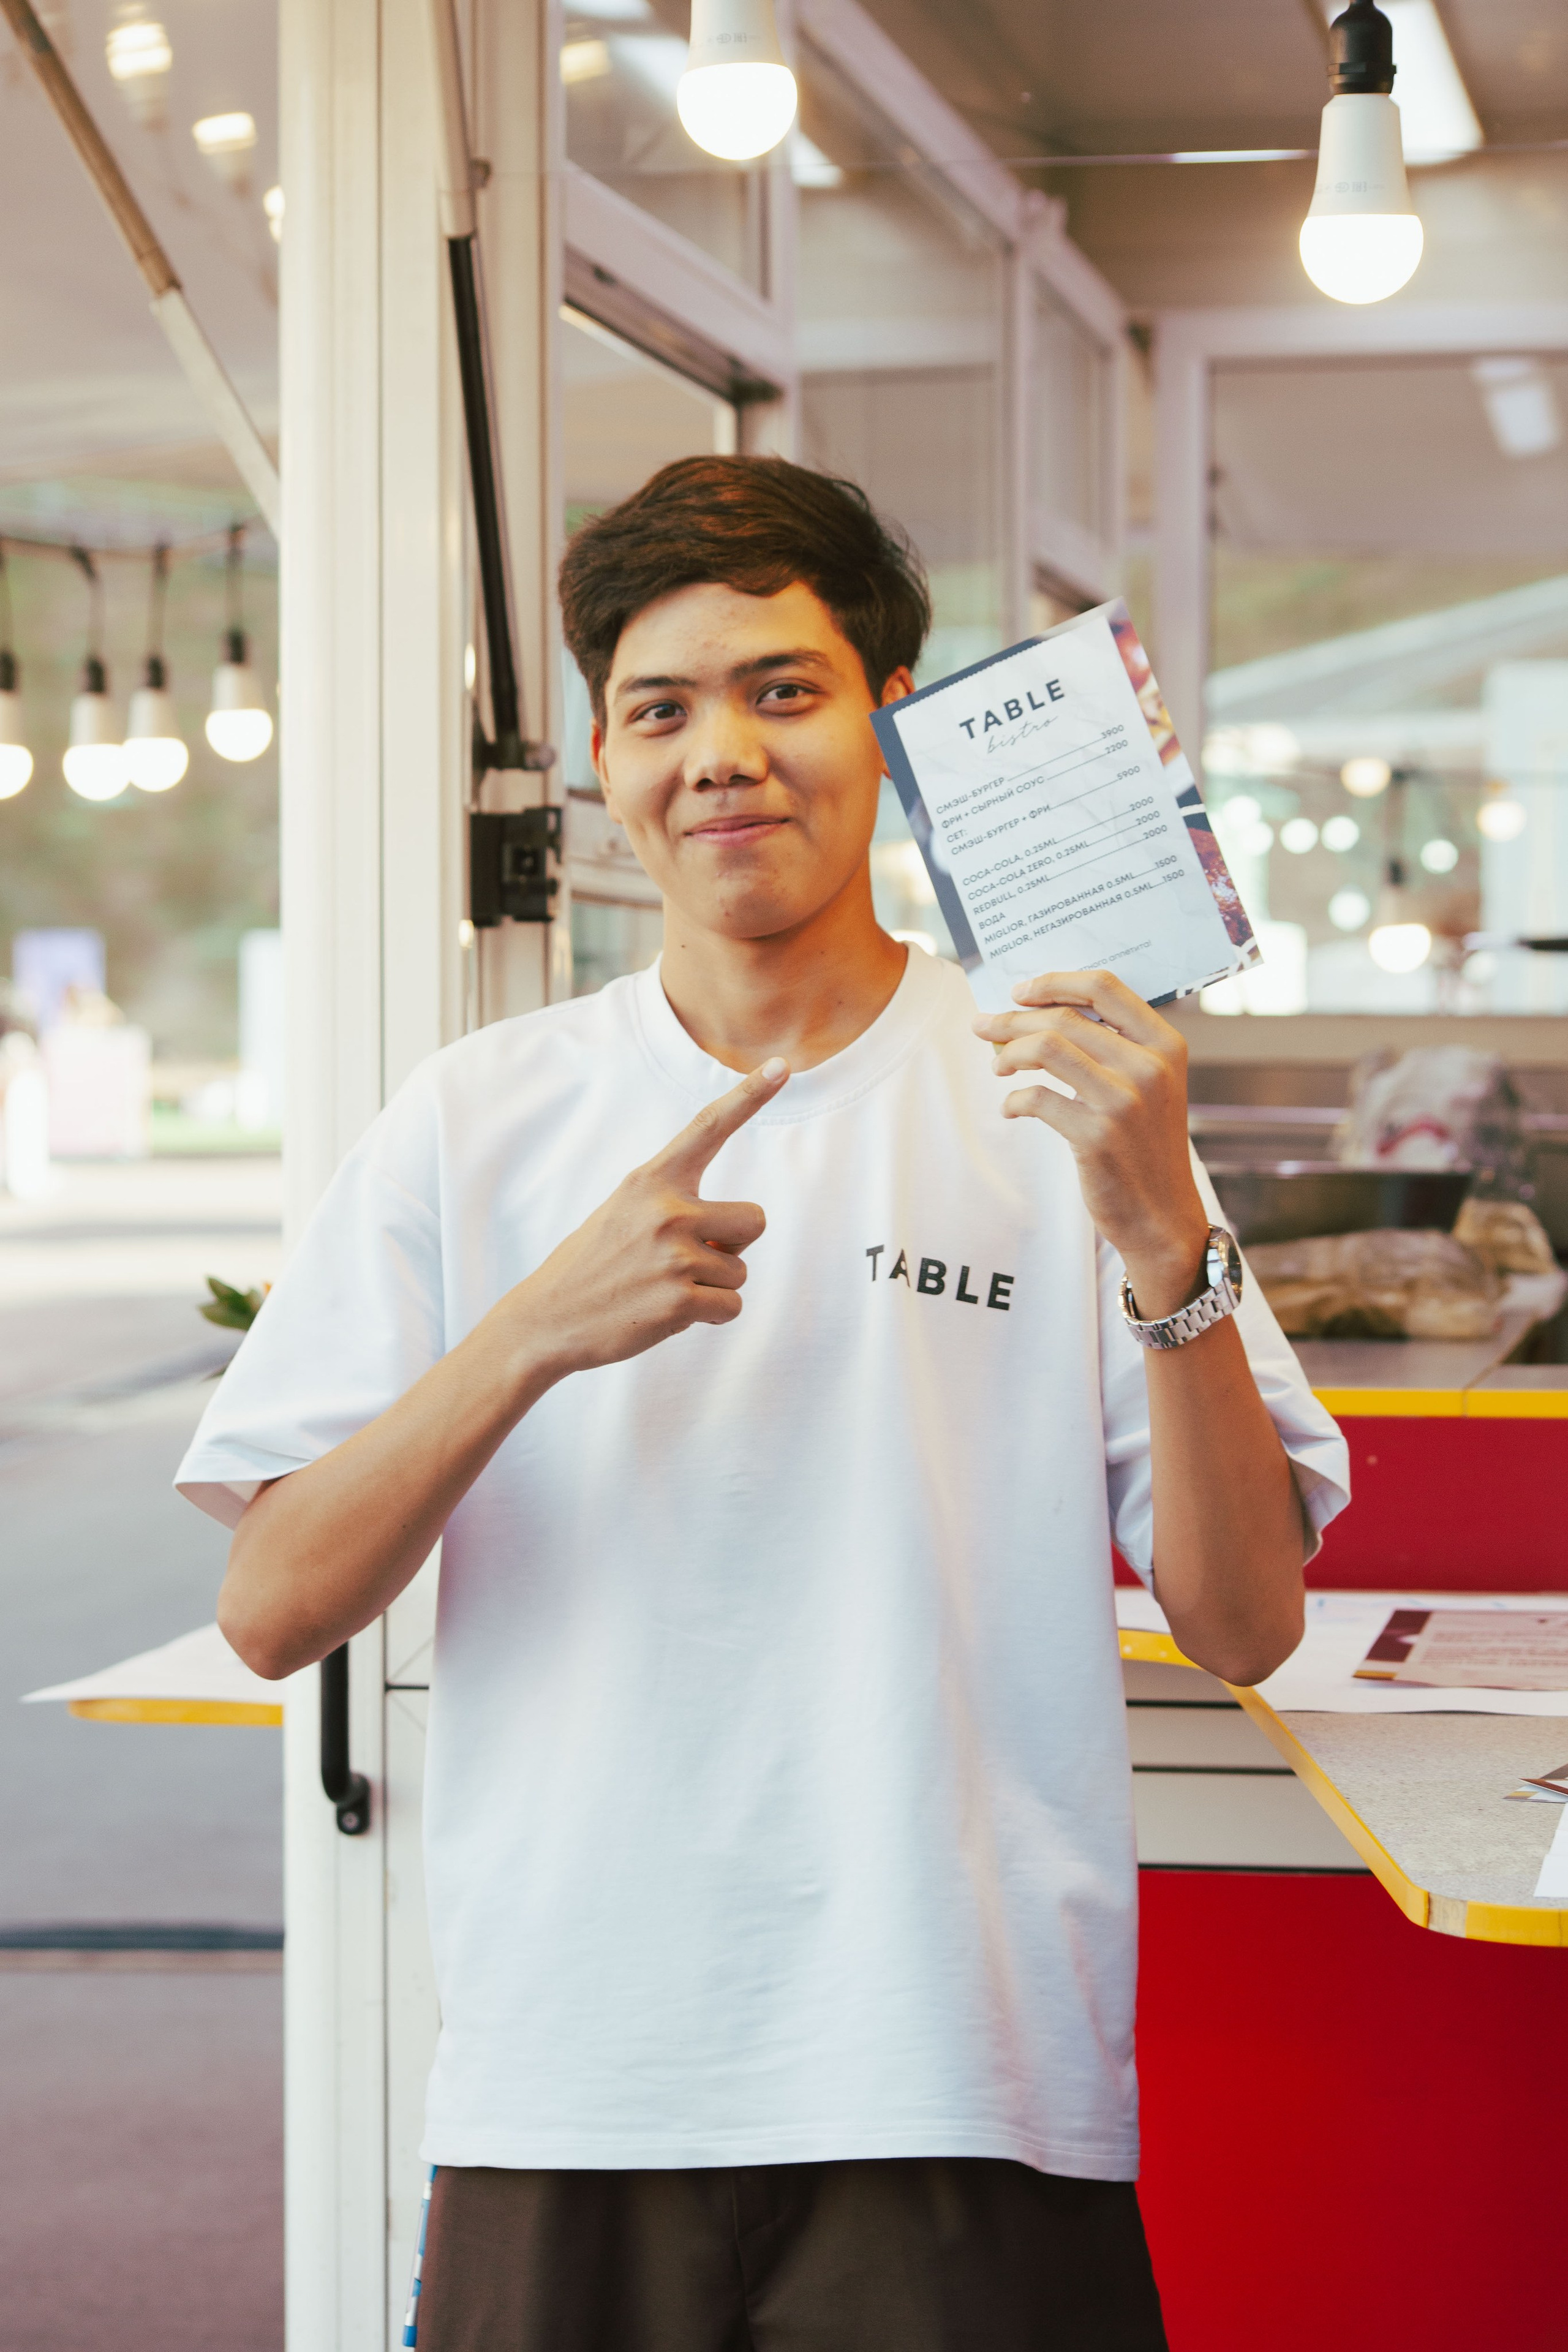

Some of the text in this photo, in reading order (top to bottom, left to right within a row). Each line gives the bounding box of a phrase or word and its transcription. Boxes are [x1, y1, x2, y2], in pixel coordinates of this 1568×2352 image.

[958, 678, 1065, 739] TABLE
[987, 715, 1058, 753] bistro
[936, 724, 1124, 814] СМЭШ-БУРГЕР 3900
[941, 813, 962, 828] ФРИ
[970, 788, 1014, 814] СЫРНЫЙ
[1015, 775, 1044, 793] СОУС
[1104, 739, 1128, 754] 2200
[951, 818, 1019, 855] СМЭШ-БУРГЕР
[1028, 804, 1052, 818] ФРИ
[1116, 765, 1140, 780] 5900
[946, 829, 967, 843] СЕТ:
[962, 796, 1154, 886] COCA-COLA, 0.25ML 2000
[968, 810, 1160, 900] COCA-COLA ZERO, 0.25ML 2000
[973, 824, 1167, 915] REDBULL, 0.25ML 2000
[978, 911, 1006, 929] ВОДА
[984, 854, 1177, 944] MIGLIOR, ГАЗИРОВАННАЯ 0.5ML 1500
[989, 869, 1185, 959] MIGLIOR, НЕГАЗИРОВАННАЯ 0.5ML 1500
[865, 1244, 1015, 1311] TABLE
